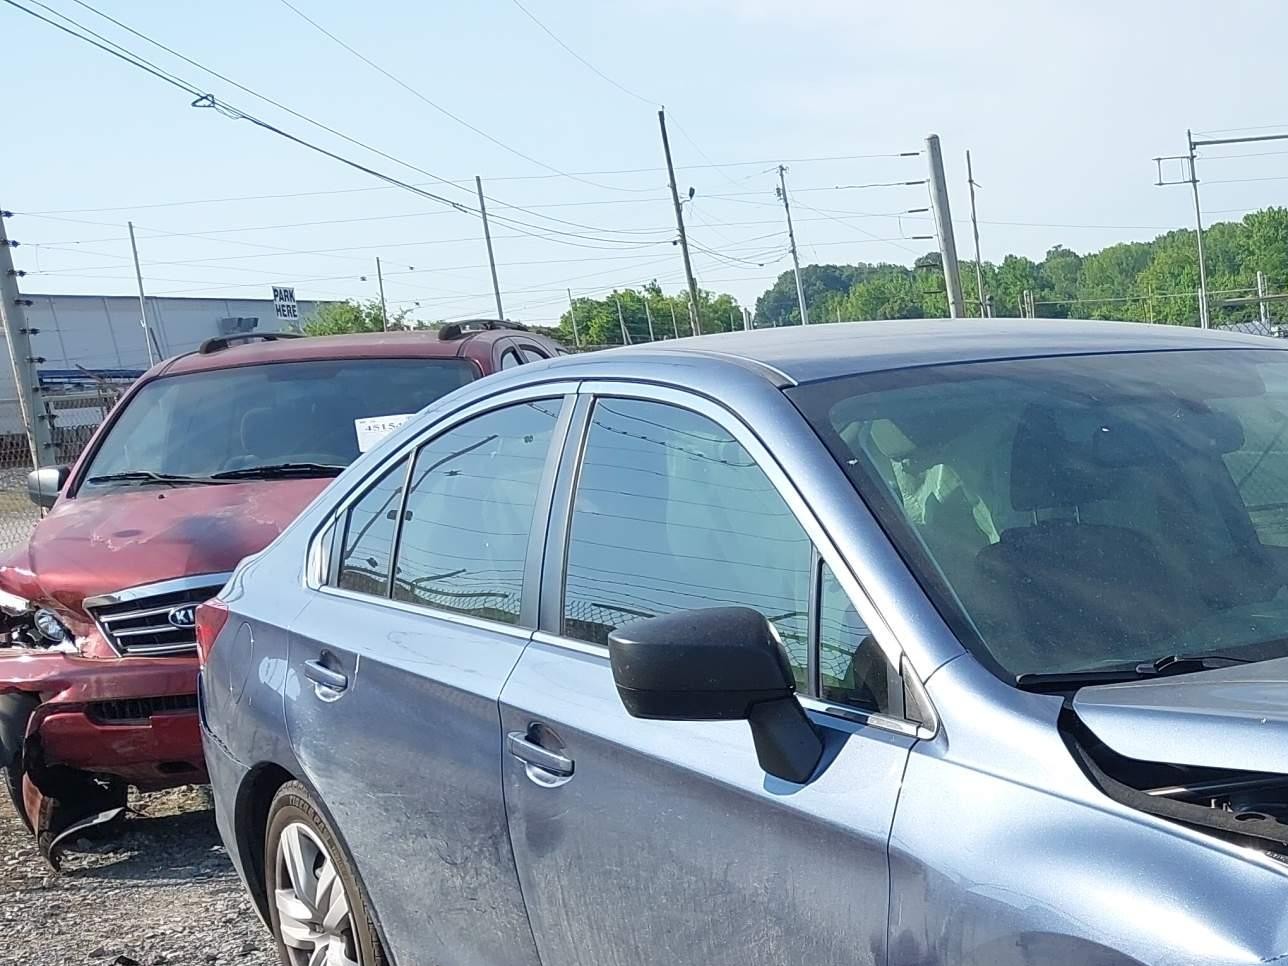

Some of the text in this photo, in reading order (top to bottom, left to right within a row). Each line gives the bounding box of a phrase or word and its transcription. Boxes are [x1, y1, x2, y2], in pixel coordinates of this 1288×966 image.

[273, 288, 296, 303] PARK
[275, 303, 298, 317] HERE
[175, 608, 195, 624] KI
